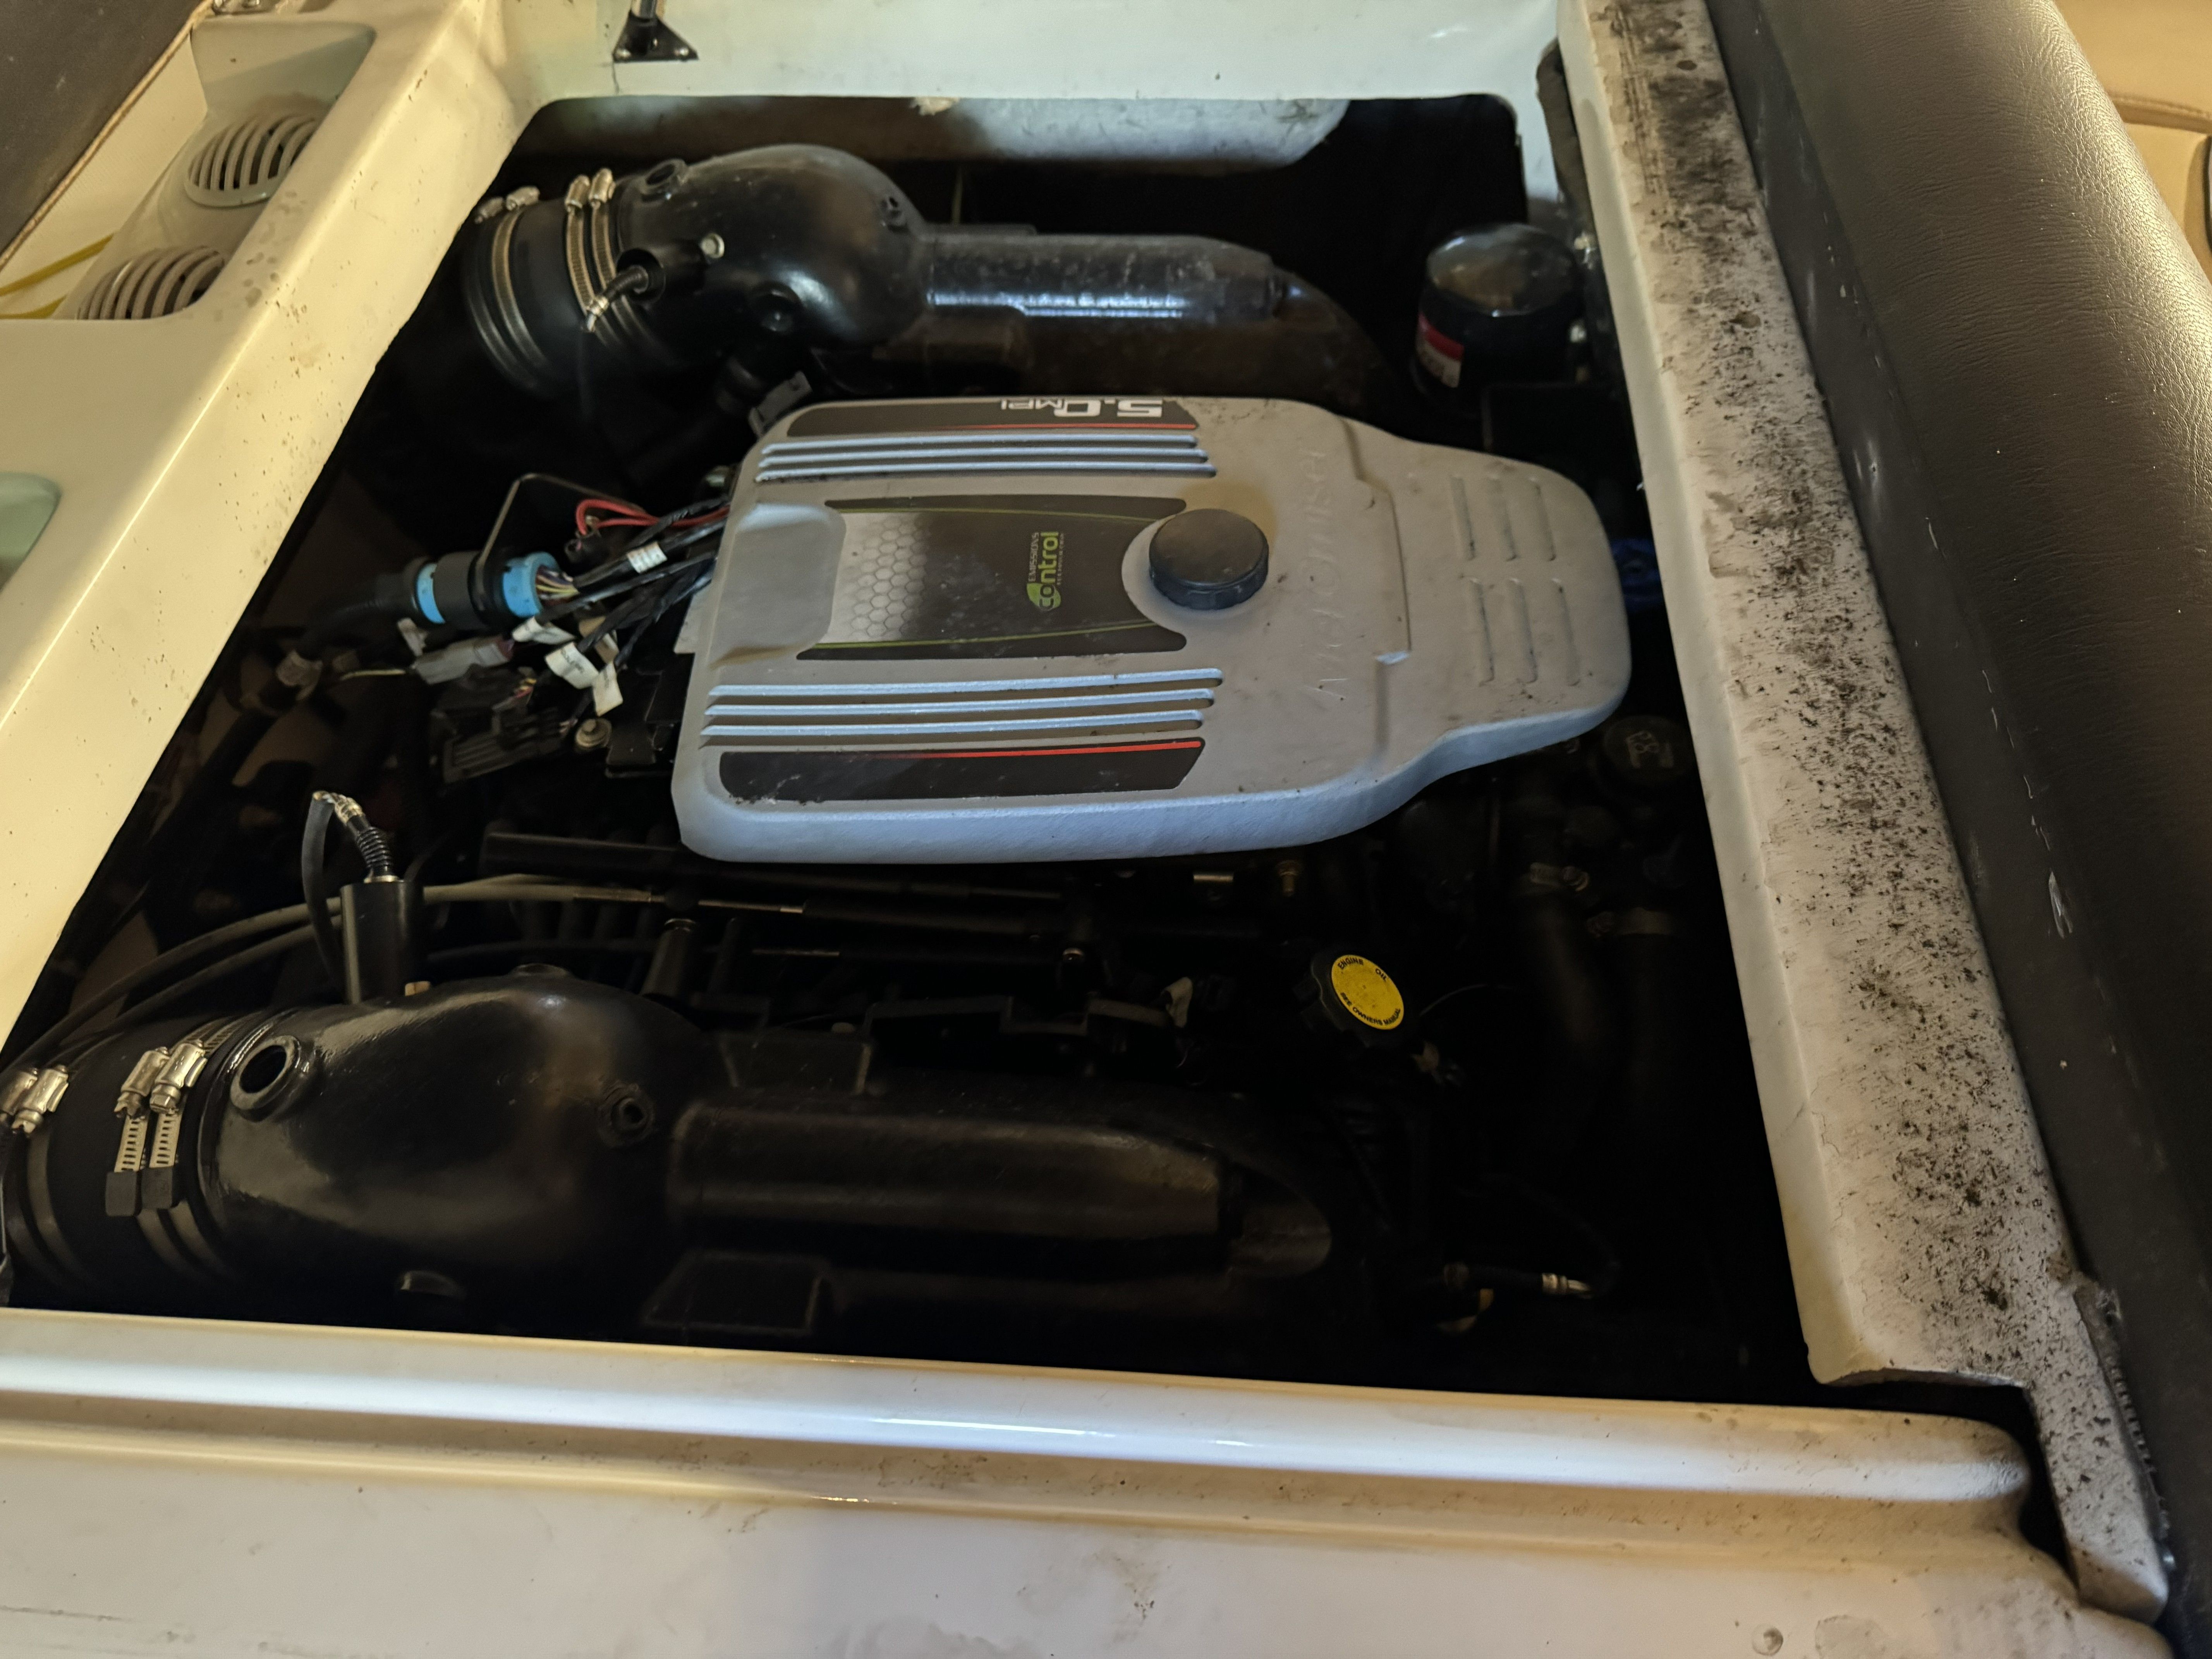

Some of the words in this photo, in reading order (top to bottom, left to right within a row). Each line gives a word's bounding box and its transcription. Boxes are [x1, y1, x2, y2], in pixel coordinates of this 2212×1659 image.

[1028, 532, 1039, 582] EMISSIONS
[1038, 532, 1059, 609] control
[1338, 957, 1364, 970] ENGINE
[1375, 968, 1387, 982] OIL
[1340, 992, 1352, 1006] SEE
[1352, 1006, 1383, 1025] OWNERS
[1383, 1008, 1401, 1025] MANUAL
